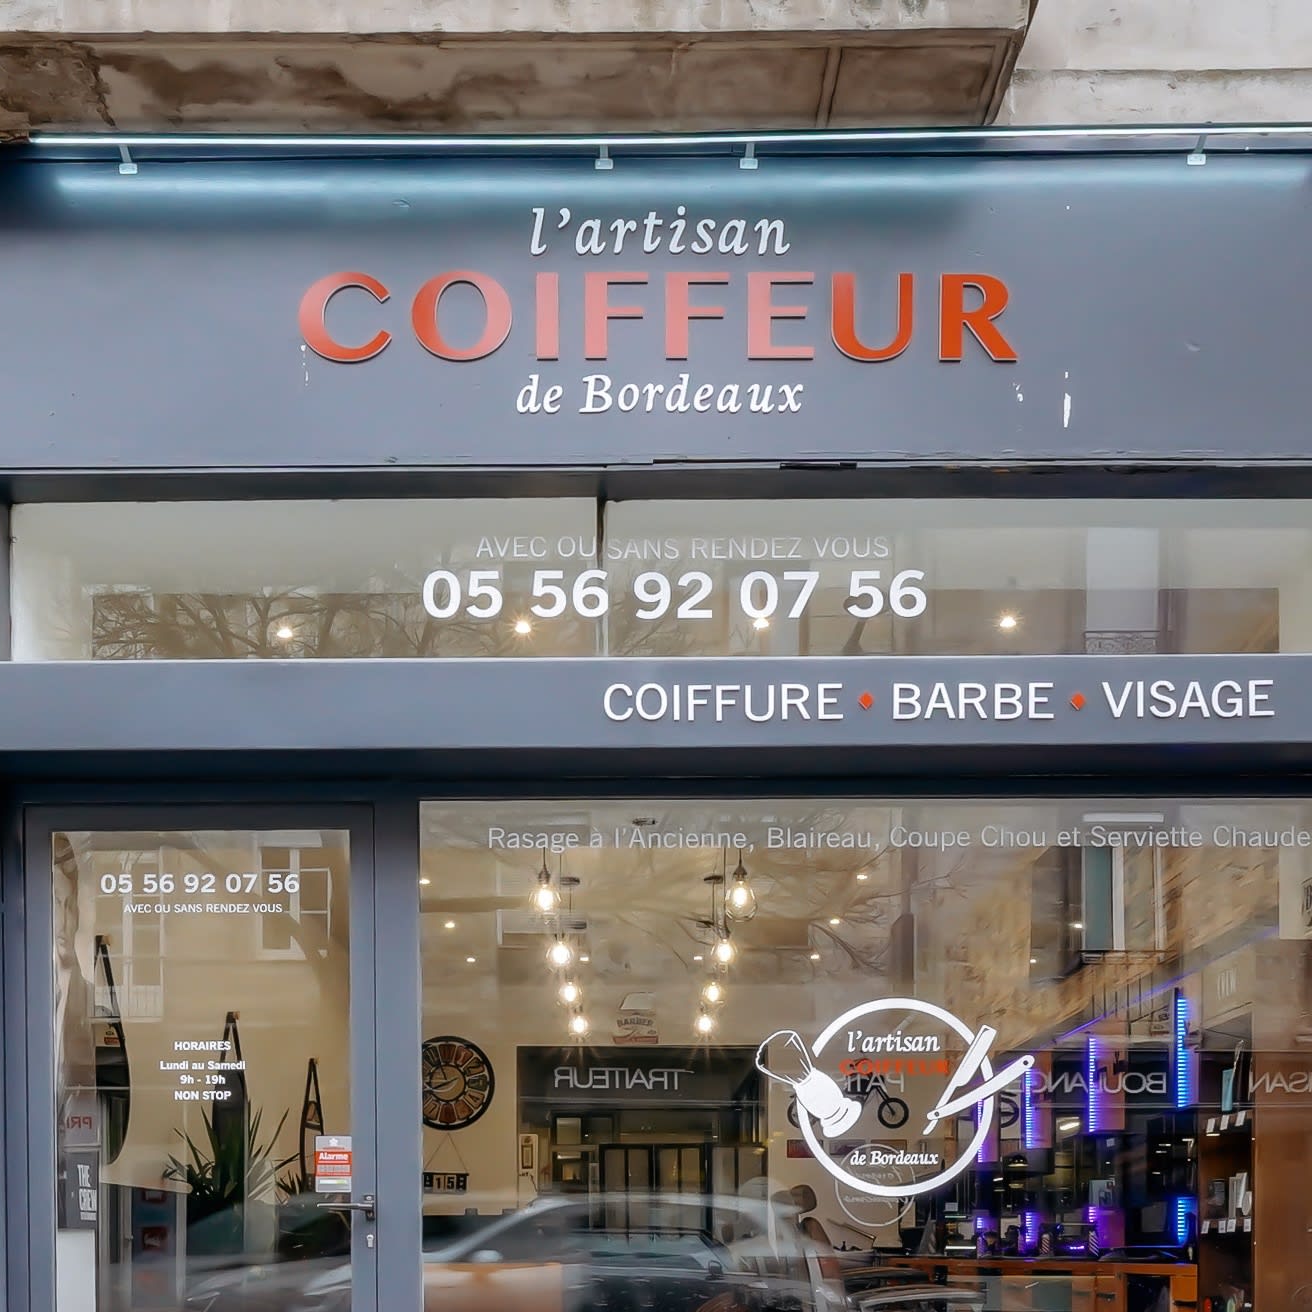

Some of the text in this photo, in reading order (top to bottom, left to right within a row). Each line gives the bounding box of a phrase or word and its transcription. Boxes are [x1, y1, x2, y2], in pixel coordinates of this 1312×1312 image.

[529, 206, 791, 258] l'artisan
[297, 270, 1019, 362] COIFFEUR
[516, 373, 804, 416] de Bordeaux
[475, 535, 890, 560] AVEC OU SANS RENDEZ VOUS
[421, 568, 928, 621] 05 56 92 07 56
[602, 679, 1275, 722] COIFFURE BARBE VISAGE
[488, 825, 1312, 853] Rasage à l'Ancienne, Blaireau, Coupe Chou et Serviette Chaude
[100, 873, 300, 895] 05 56 92 07 56
[124, 903, 283, 914] AVEC OU SANS RENDEZ VOUS
[174, 1040, 231, 1051] HORAIRES
[847, 1031, 940, 1053] l'artisan
[159, 1060, 246, 1071] Lundi au Samedi
[180, 1074, 195, 1085] 9h
[205, 1074, 226, 1085] 19h
[174, 1091, 232, 1101] NON STOP
[319, 1152, 349, 1161] Alarme
[850, 1150, 939, 1166] de Bordeaux
